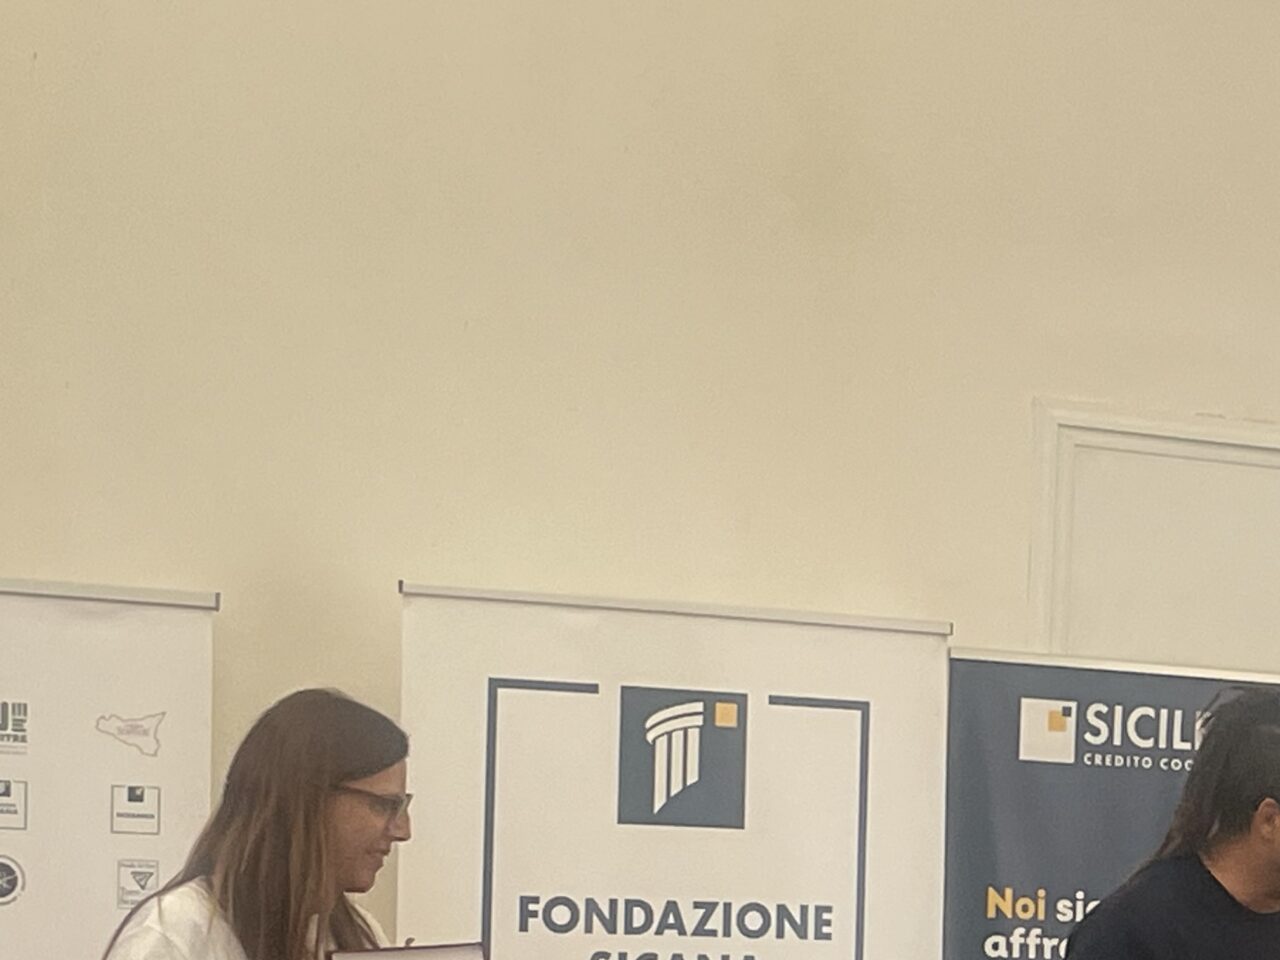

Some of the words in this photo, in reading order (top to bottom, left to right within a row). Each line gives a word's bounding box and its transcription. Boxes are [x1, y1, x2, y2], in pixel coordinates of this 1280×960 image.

[1083, 752, 1153, 769] CREDITO
[518, 895, 834, 941] FONDAZIONE
[986, 885, 1047, 921] Noi
